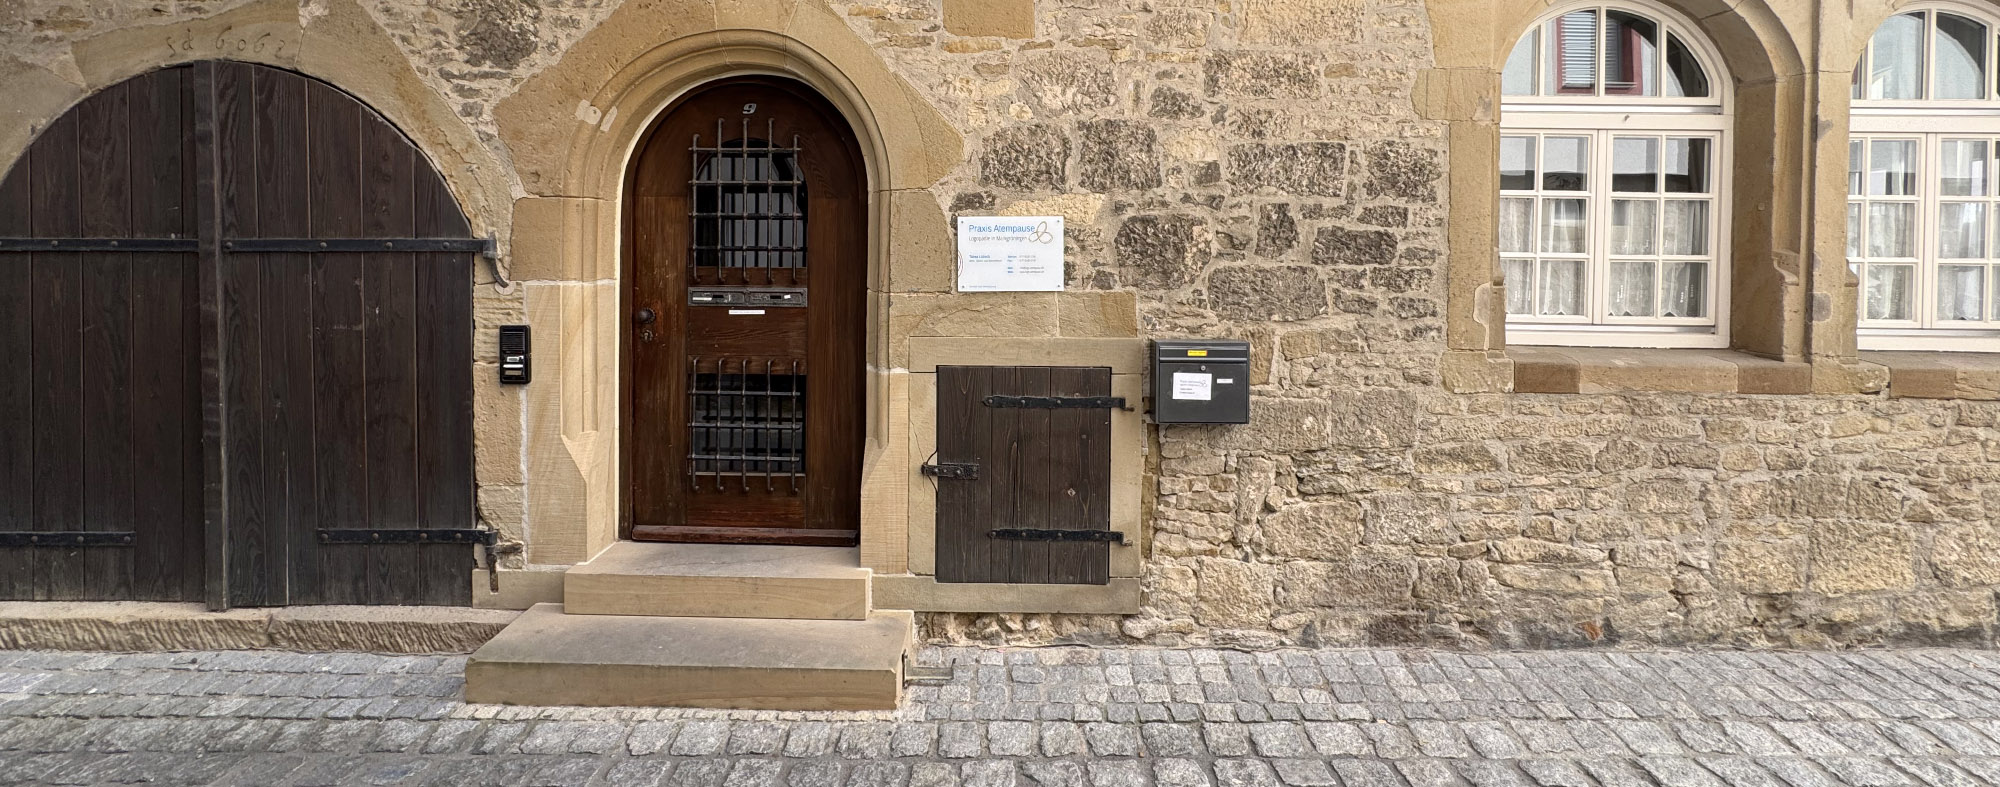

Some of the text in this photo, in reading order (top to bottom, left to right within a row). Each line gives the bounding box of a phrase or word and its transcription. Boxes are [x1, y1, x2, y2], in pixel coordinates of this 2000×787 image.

[742, 103, 757, 115] 9
[968, 224, 1035, 234] Praxis Atempause
